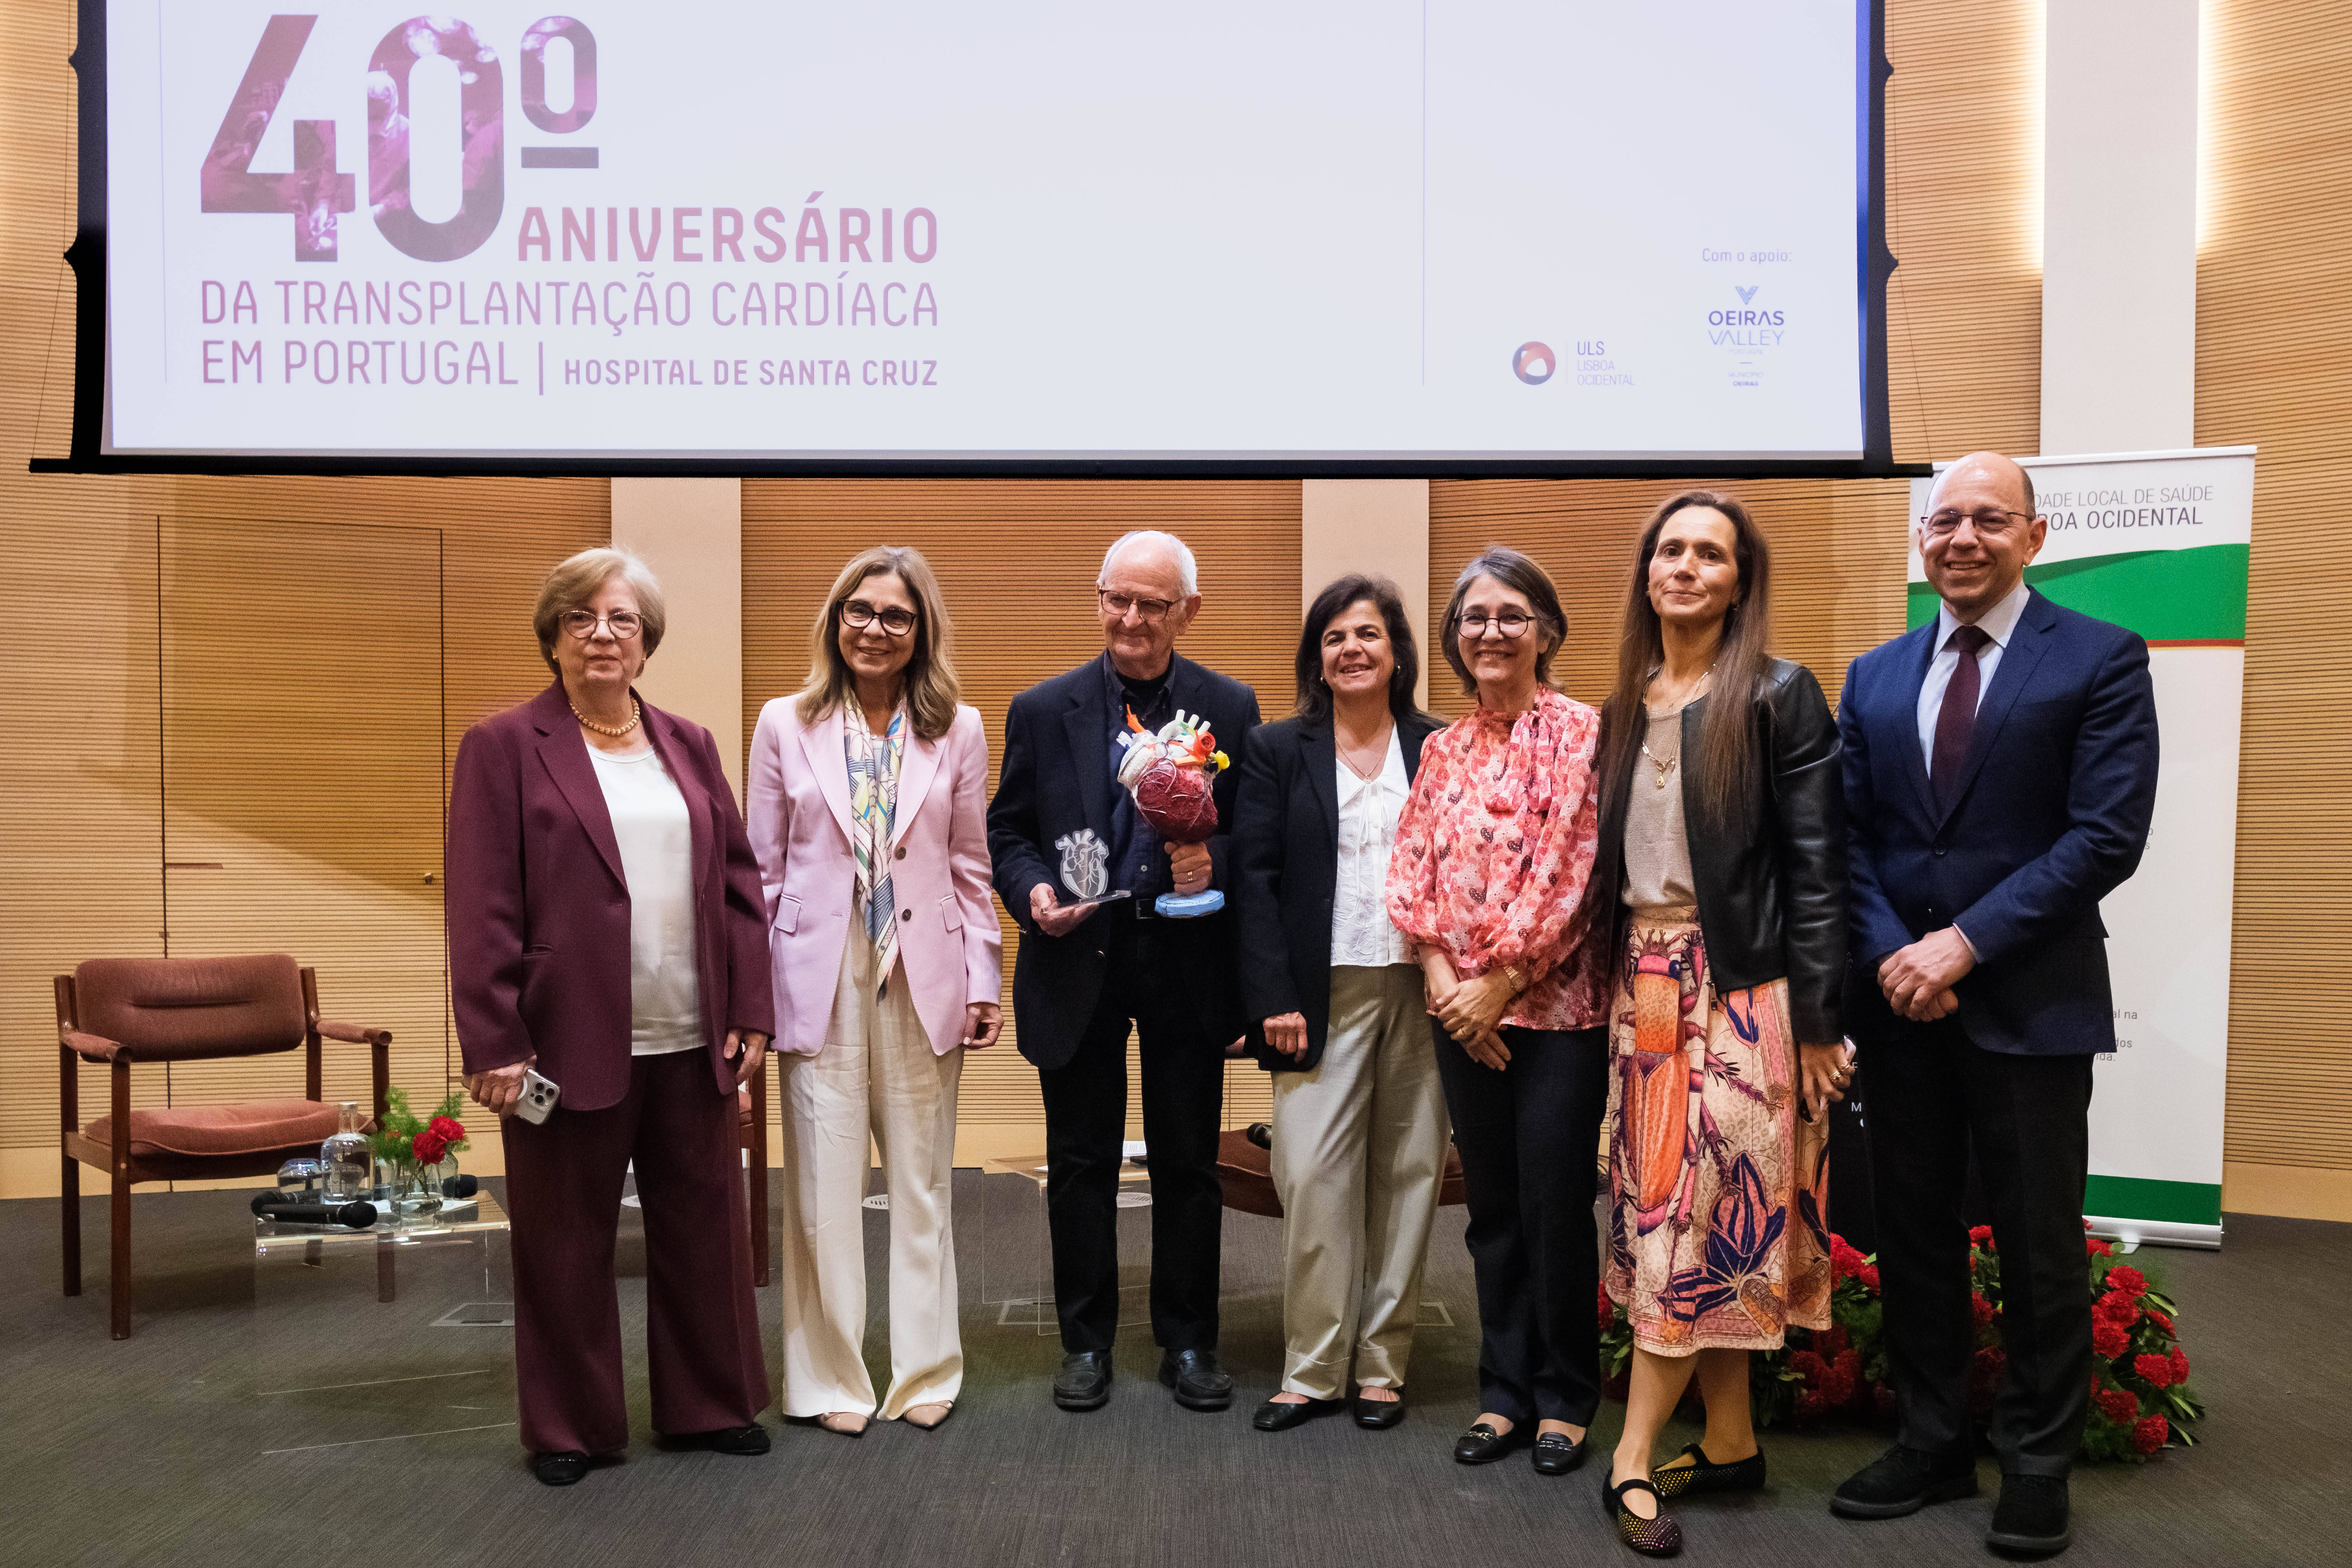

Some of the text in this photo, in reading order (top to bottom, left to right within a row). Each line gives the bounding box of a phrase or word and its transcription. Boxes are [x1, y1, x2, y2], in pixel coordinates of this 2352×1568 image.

[518, 191, 938, 264] ANIVERSÁRIO
[1703, 247, 1792, 265] Com o apoio:
[202, 271, 938, 337] DA TRANSPLANTAÇÃO CARDÍACA
[1708, 310, 1785, 326] OEIRAS
[1707, 329, 1785, 346] VALLEY
[1577, 341, 1605, 356] ULS
[203, 340, 938, 386] EM PORTUGAL HOSPITAL DE SANTA CRUZ
[1577, 359, 1615, 372] LISBOA
[1577, 374, 1636, 386] OCIDENTAL
[2034, 483, 2214, 508] DADE LOCAL DE SAÚDE
[2087, 507, 2204, 529] OCIDENTAL
